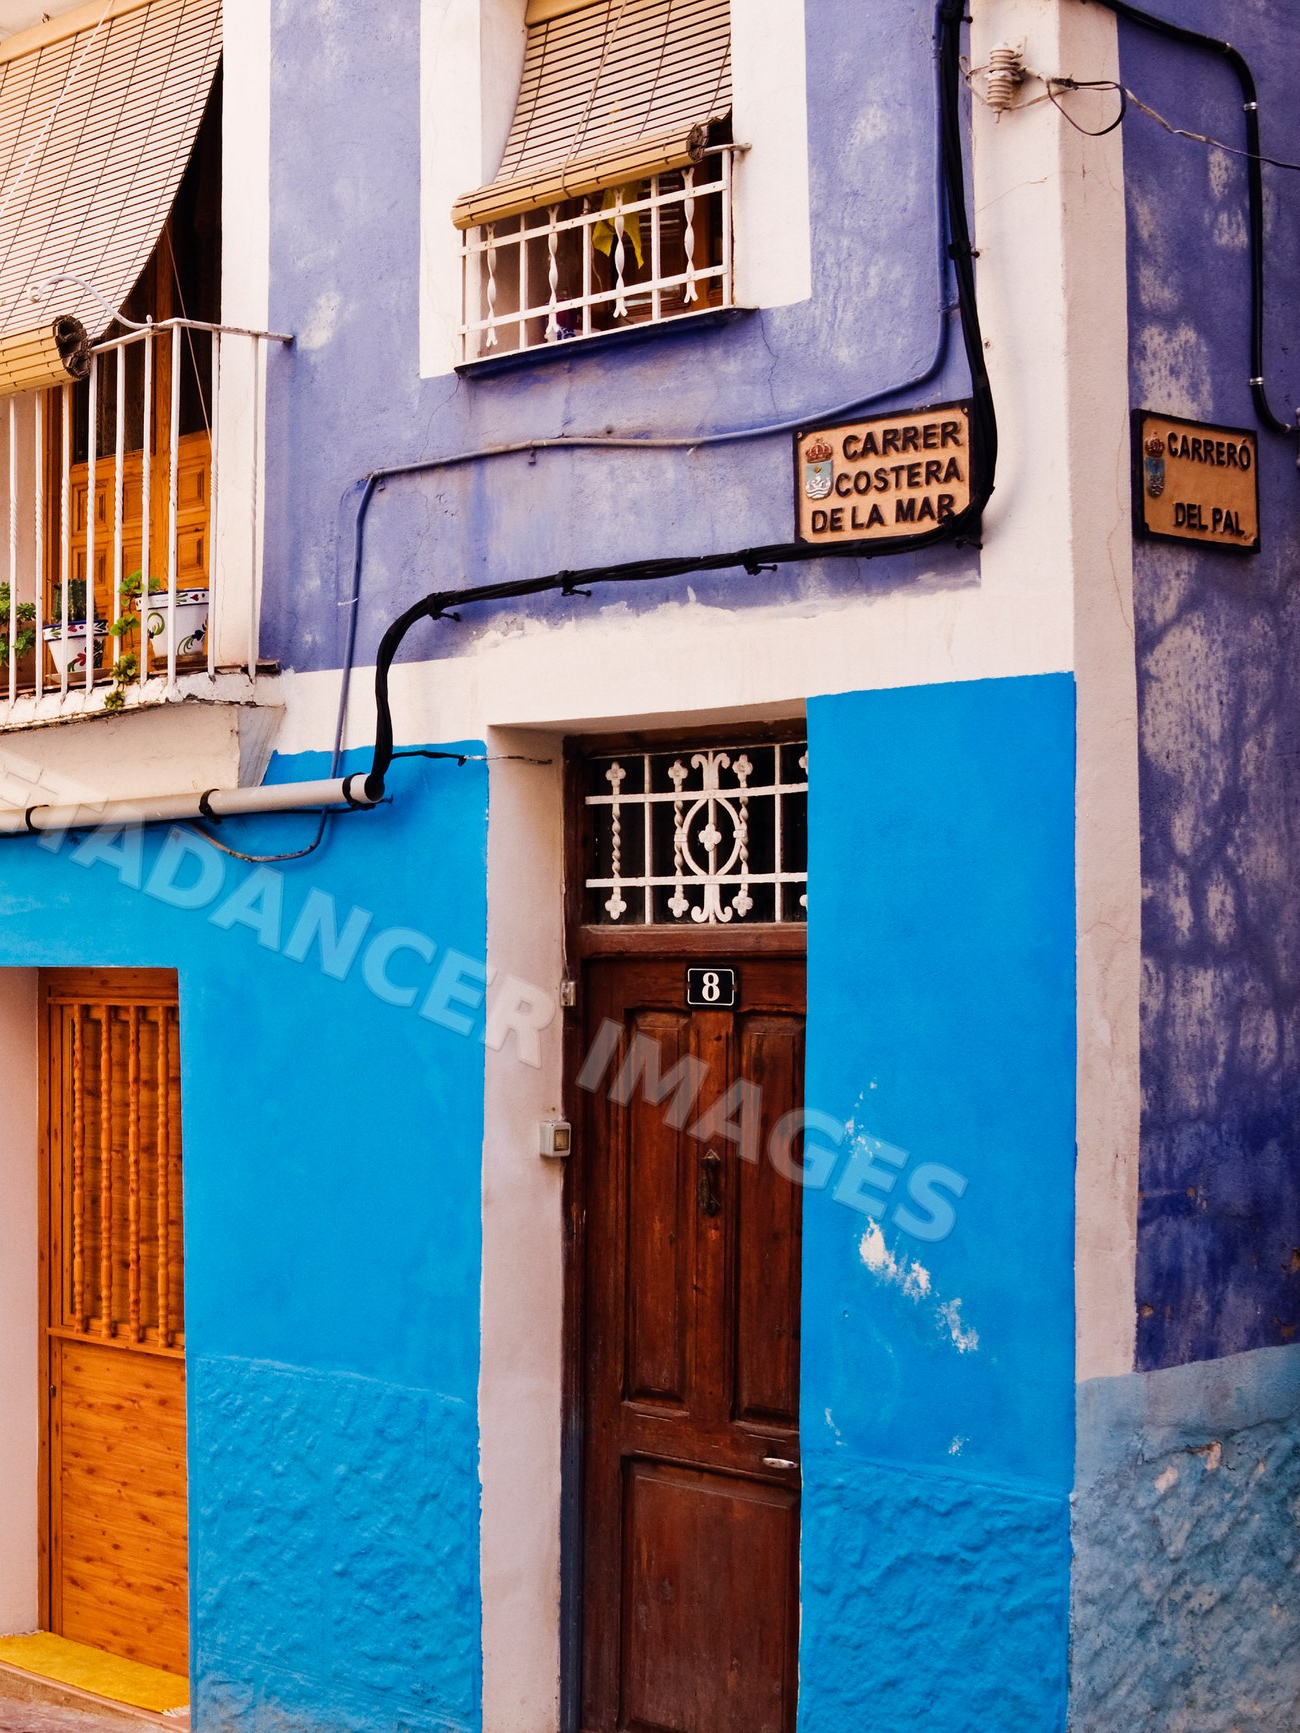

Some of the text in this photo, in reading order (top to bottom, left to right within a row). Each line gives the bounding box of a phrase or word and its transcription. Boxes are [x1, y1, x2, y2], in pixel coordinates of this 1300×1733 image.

[842, 421, 962, 460] CARRER
[1167, 431, 1251, 472] CARRERÓ
[835, 457, 962, 497] COSTERA
[812, 494, 956, 533] DE LA MAR
[1173, 502, 1245, 537] DEL PAL
[702, 972, 720, 1002] 8
